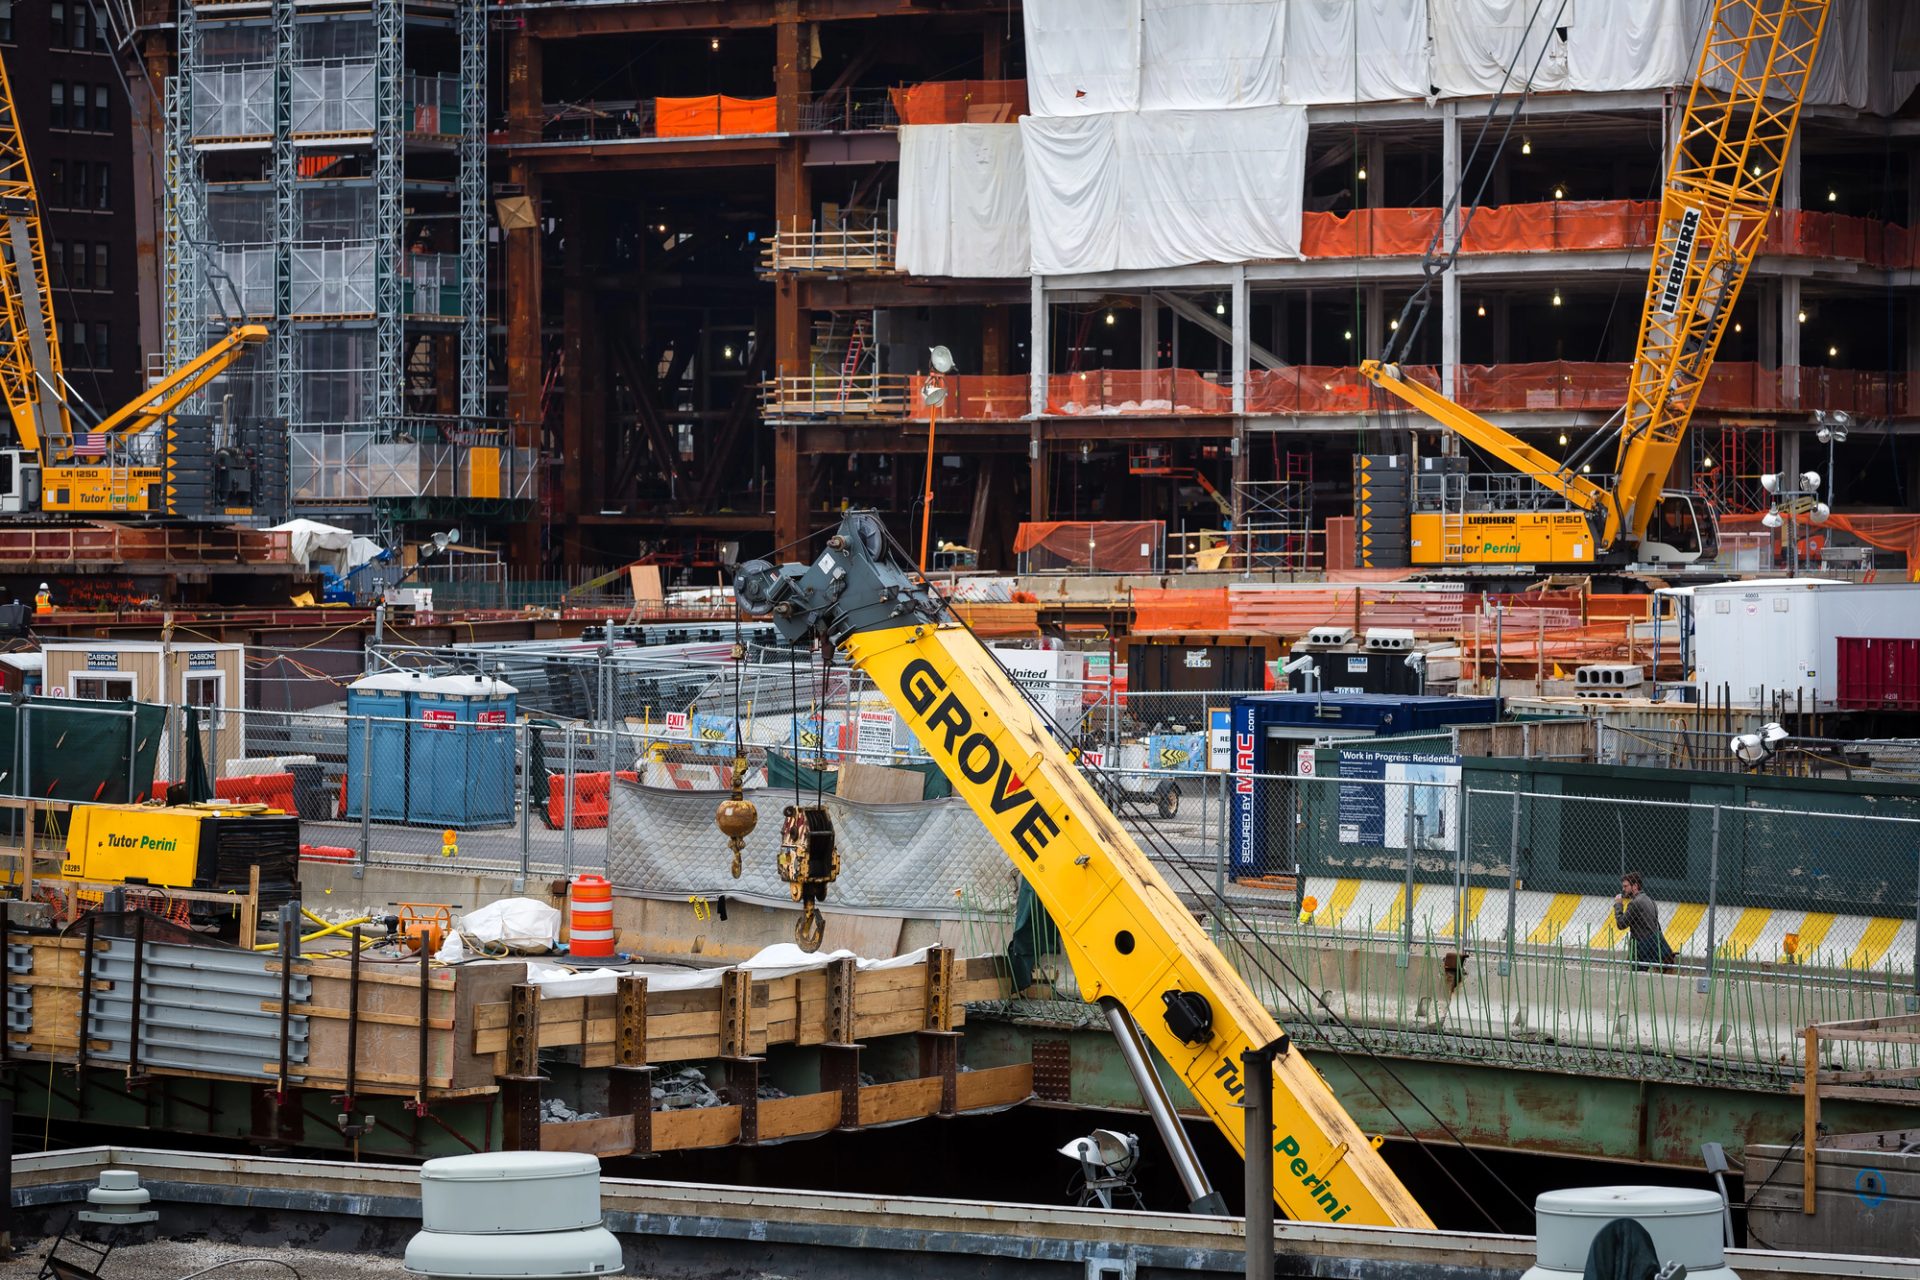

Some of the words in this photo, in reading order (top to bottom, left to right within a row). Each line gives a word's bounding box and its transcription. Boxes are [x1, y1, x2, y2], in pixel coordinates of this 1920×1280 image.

[1661, 211, 1699, 314] LIEBHERR
[80, 493, 105, 503] Tutor
[1468, 516, 1516, 525] LIEBHERR
[1553, 516, 1582, 524] 1250
[1448, 544, 1480, 554] Tutor
[1483, 543, 1521, 554] Perini
[88, 653, 117, 661] CASSONE
[1007, 668, 1048, 679] United
[667, 714, 685, 726] EXIT
[861, 712, 893, 722] WARNING
[899, 658, 1061, 863] GROVE
[1342, 751, 1364, 760] Work
[1365, 751, 1373, 760] in
[1375, 752, 1411, 763] Progress:
[1412, 754, 1457, 764] Residential
[1242, 795, 1251, 809] BY
[108, 833, 138, 848] Tutor
[140, 835, 177, 851] Perini
[1242, 813, 1251, 863] SECURED
[1273, 1135, 1352, 1222] Perini
